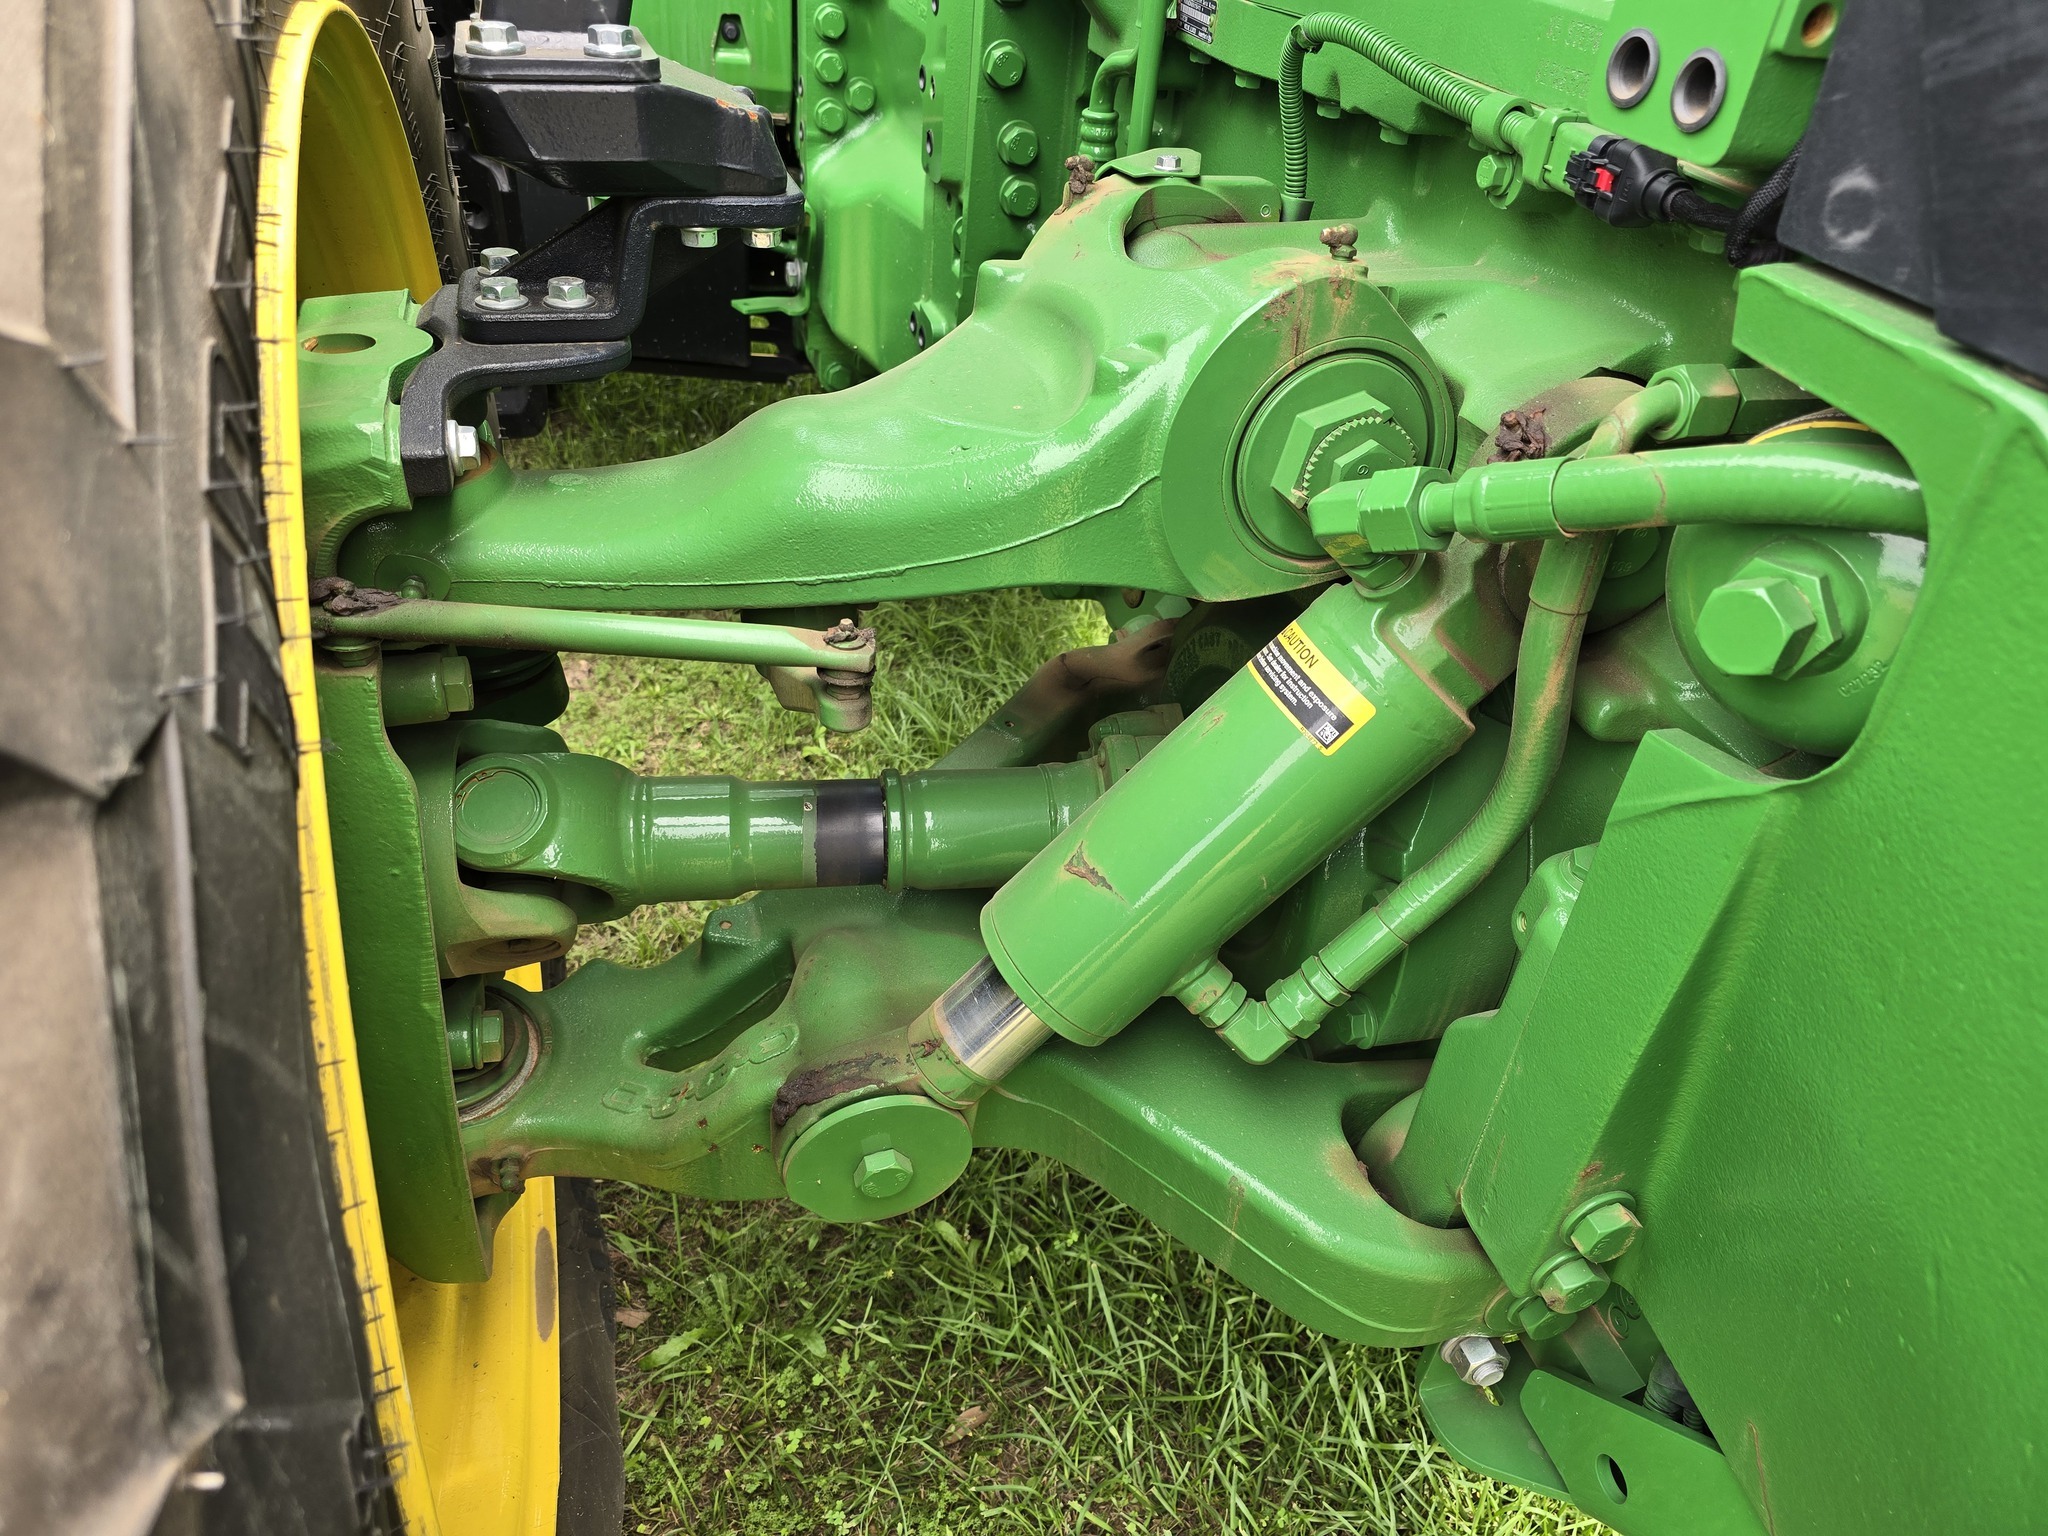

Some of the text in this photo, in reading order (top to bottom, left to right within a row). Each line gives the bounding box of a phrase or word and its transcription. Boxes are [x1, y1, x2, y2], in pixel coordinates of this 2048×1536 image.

[1283, 628, 1319, 668] CAUTION
[1278, 653, 1301, 682] movement
[1298, 678, 1312, 692] and
[1308, 688, 1338, 721] exposure
[1278, 683, 1297, 706] system.
[1279, 670, 1289, 682] for
[1285, 677, 1314, 709] instruction
